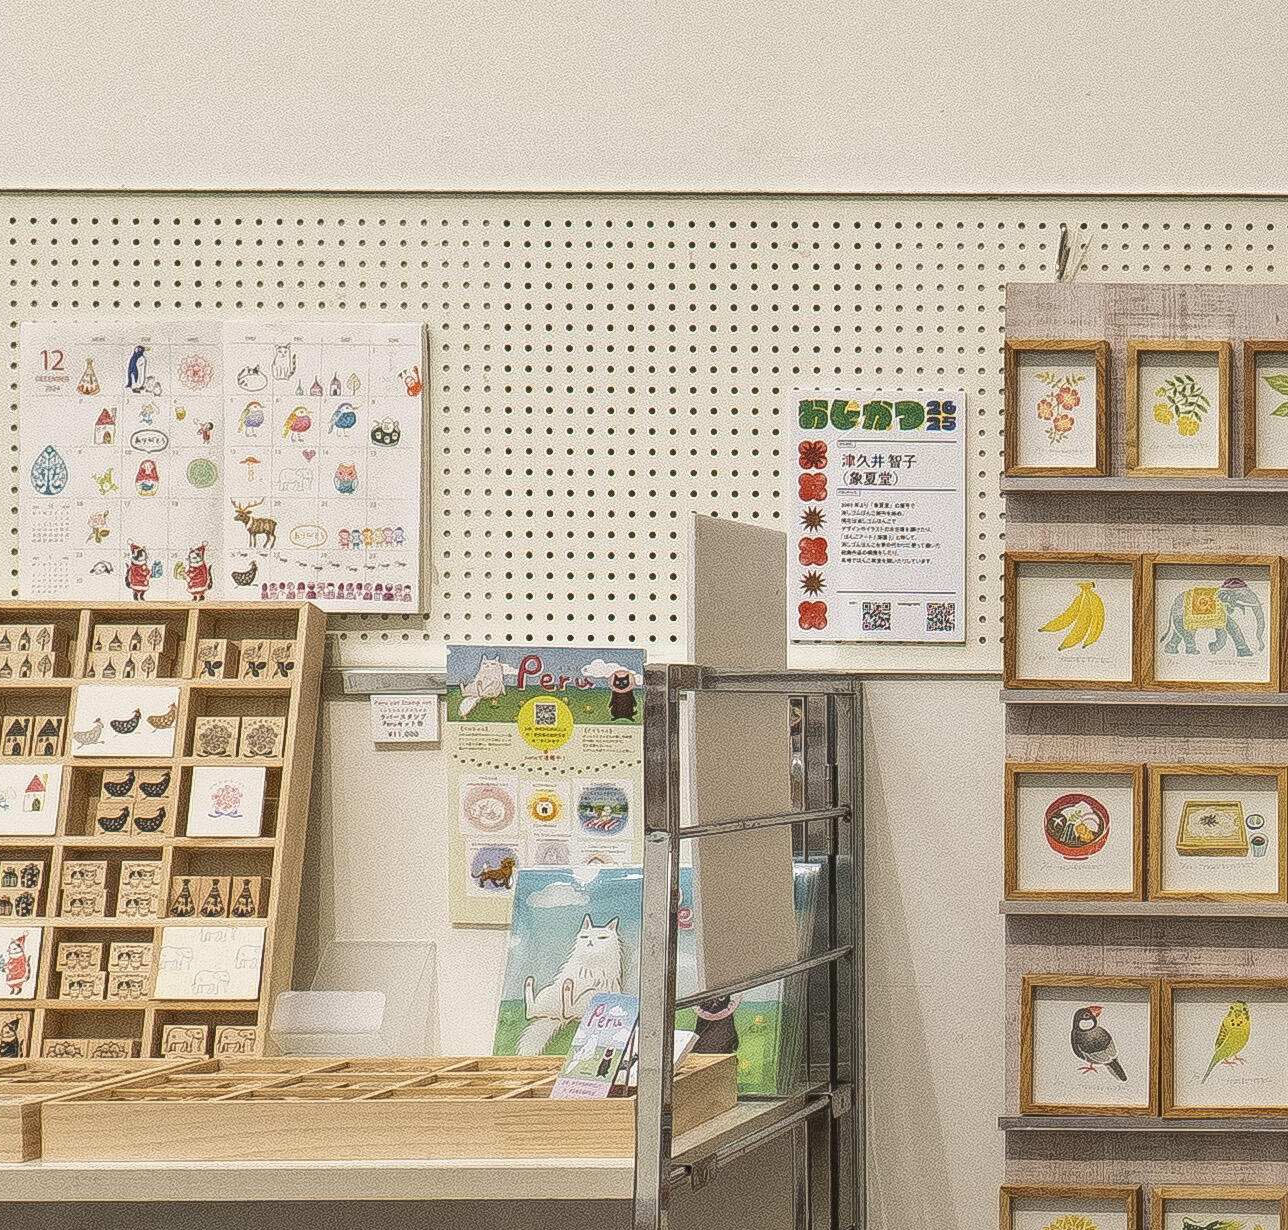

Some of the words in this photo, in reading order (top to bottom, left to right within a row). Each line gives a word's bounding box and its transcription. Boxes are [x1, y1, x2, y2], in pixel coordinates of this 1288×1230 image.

[40, 349, 66, 371] 12
[797, 399, 926, 431] おしかつ
[841, 454, 885, 469] 津久井
[888, 454, 918, 469] 智子
[517, 654, 596, 692] Peru
[388, 730, 419, 738] ¥11,000
[587, 1003, 623, 1028] Peru
